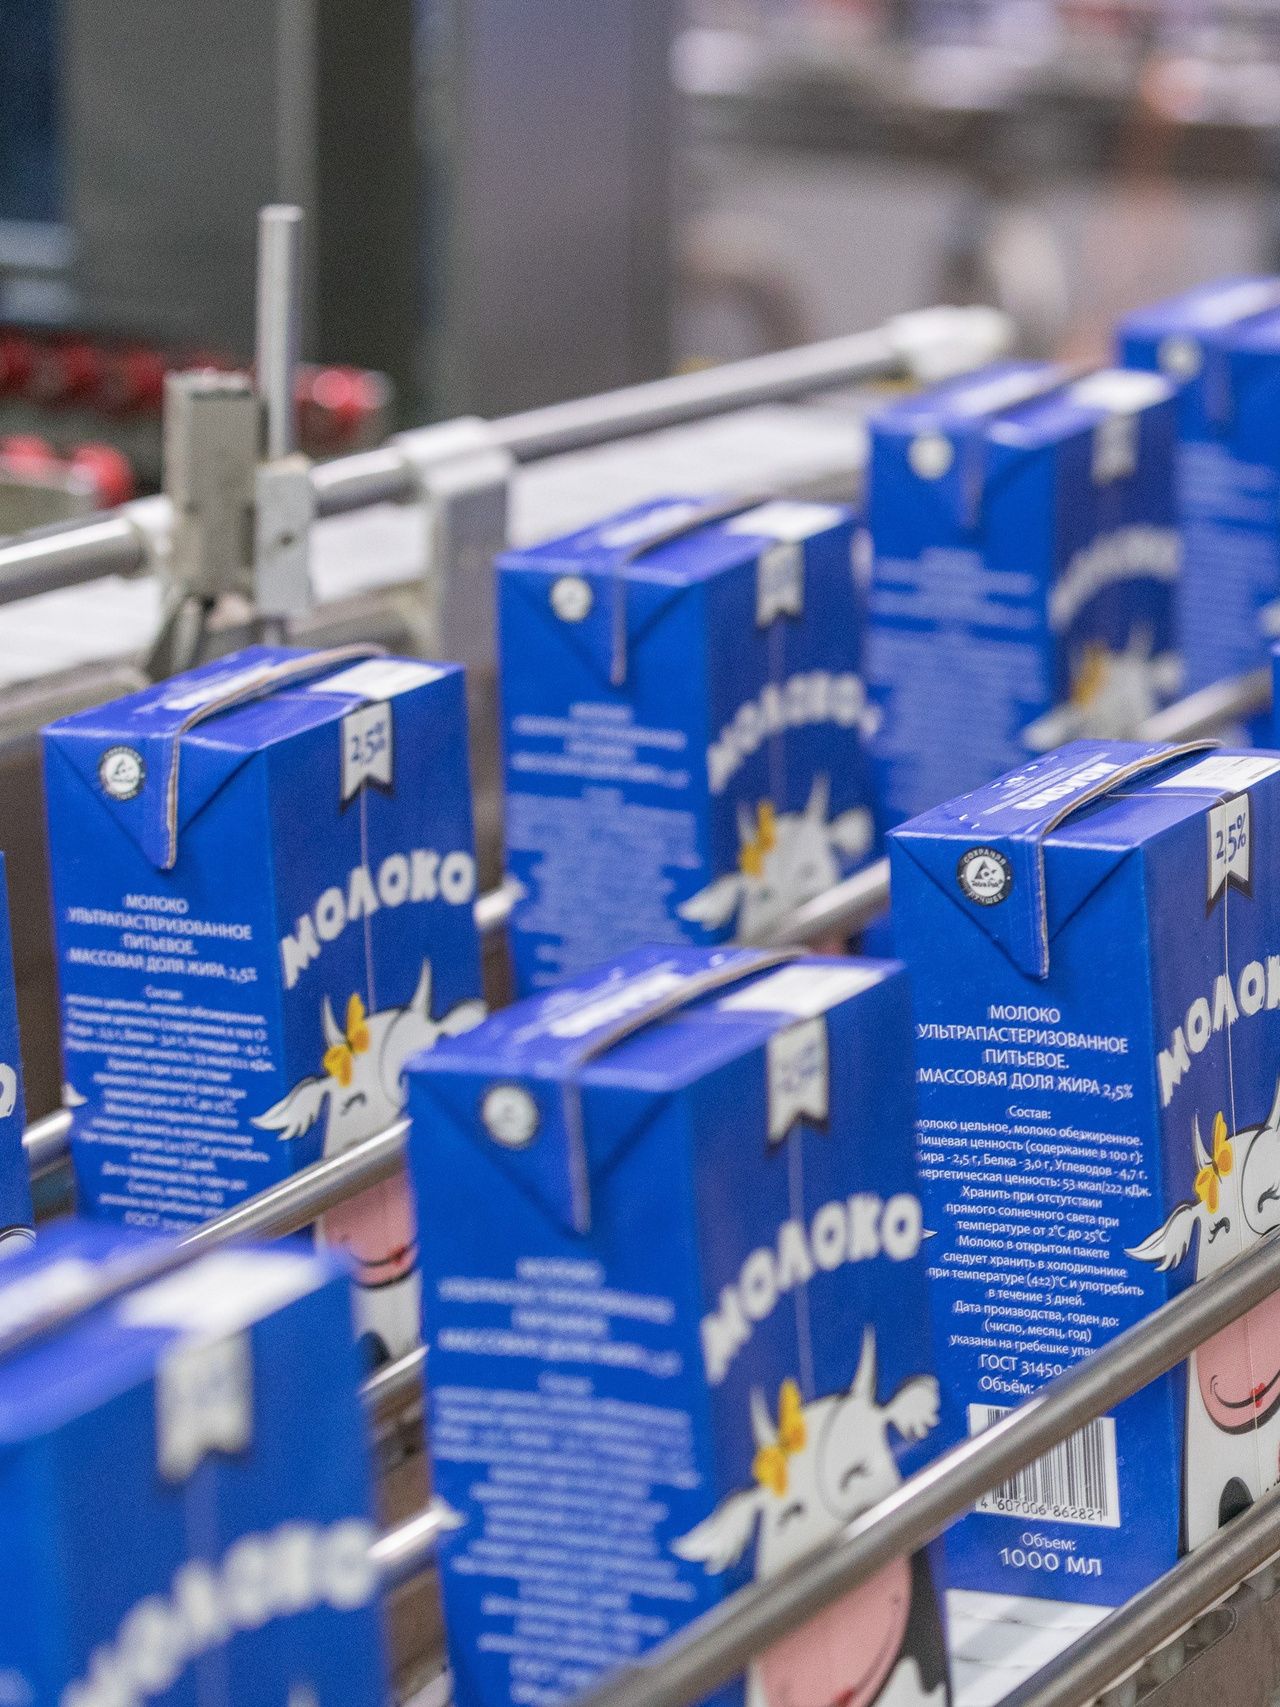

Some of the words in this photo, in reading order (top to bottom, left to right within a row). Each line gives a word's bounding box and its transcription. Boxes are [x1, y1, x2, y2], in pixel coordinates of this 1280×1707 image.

[280, 849, 477, 989] МОЛОКО
[989, 1005, 1061, 1024] МОЛОКО
[918, 1024, 1128, 1053] УЛЬТРАПАСТЕРИЗОВАННОЕ
[984, 1049, 1069, 1069] ПИТЬЕВОЕ.
[919, 1068, 1007, 1086] МАССОВАЯ
[1011, 1073, 1054, 1090] ДОЛЯ
[1058, 1077, 1100, 1094] ЖИРА
[1104, 1084, 1133, 1101] 2,5%
[1008, 1105, 1051, 1120] Состав:
[961, 1122, 1012, 1135] цельное,
[1014, 1125, 1056, 1137] молоко
[1059, 1128, 1143, 1146] обезжиренное.
[970, 1139, 1023, 1153] ценность
[1026, 1140, 1097, 1160] (содержание
[1109, 1151, 1128, 1161] 100
[1130, 1150, 1144, 1164] г):
[953, 1154, 970, 1166] 2,5
[984, 1154, 1016, 1167] Белка
[1025, 1160, 1042, 1171] 3,0
[1054, 1160, 1112, 1177] Углеводов
[1120, 1169, 1137, 1182] 4,7
[962, 1186, 1010, 1200] Хранить
[1013, 1191, 1034, 1203] при
[1005, 1174, 1061, 1188] ценность:
[1063, 1180, 1075, 1191] 53
[1125, 1184, 1152, 1197] кДж.
[946, 1202, 996, 1216] прямого
[998, 1206, 1064, 1221] солнечного
[1066, 1212, 1096, 1224] света
[1098, 1216, 1119, 1228] при
[957, 1220, 1030, 1237] температуре
[1033, 1226, 1046, 1235] от
[1068, 1230, 1082, 1241] до
[958, 1235, 1004, 1249] Молоко
[1016, 1242, 1071, 1256] открытом
[1074, 1247, 1110, 1259] пакете
[943, 1252, 987, 1266] следует
[990, 1255, 1035, 1269] хранить
[1047, 1260, 1127, 1278] холодильнике
[700, 1191, 924, 1386] МОЛОКО
[928, 1266, 950, 1279] при
[952, 1268, 1025, 1286] температуре
[1078, 1280, 1144, 1296] употребить
[998, 1290, 1043, 1302] течение
[1045, 1293, 1052, 1305] 3
[1054, 1293, 1085, 1307] дней.
[954, 1300, 981, 1314] Дата
[984, 1306, 1064, 1323] производства,
[1068, 1312, 1099, 1325] годен
[1102, 1316, 1120, 1328] до:
[984, 1318, 1025, 1335] (число,
[1028, 1326, 1065, 1339] месяц,
[1068, 1328, 1092, 1343] год)
[950, 1334, 996, 1347] указаны
[1000, 1340, 1012, 1349] на
[1015, 1340, 1069, 1355] гребешке
[980, 1354, 1018, 1372] ГОСТ
[1022, 1361, 1074, 1378] 31450-
[981, 1375, 1035, 1395] Объём:
[980, 1496, 988, 1509] 4
[998, 1499, 1047, 1516] 607006
[1054, 1506, 1103, 1522] 862821
[1022, 1532, 1077, 1551] Объем:
[1000, 1548, 1060, 1571] 1000
[1067, 1556, 1102, 1577] МЛ
